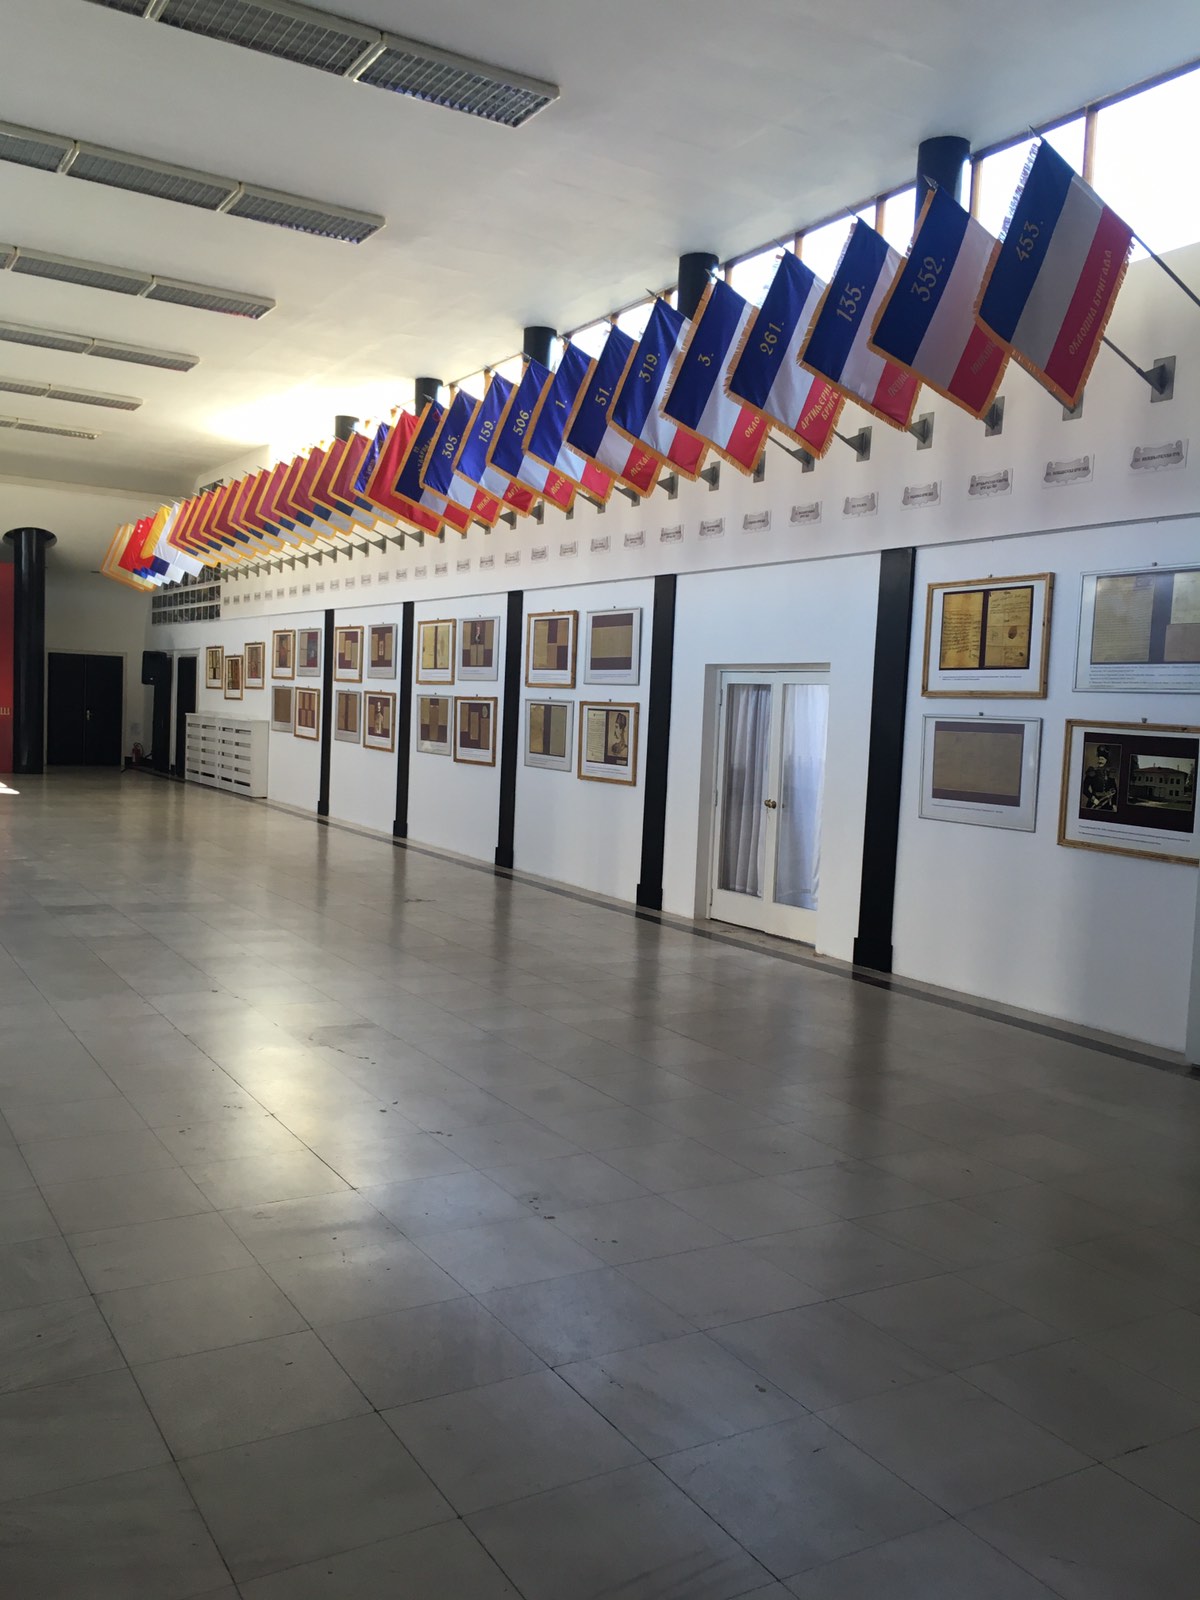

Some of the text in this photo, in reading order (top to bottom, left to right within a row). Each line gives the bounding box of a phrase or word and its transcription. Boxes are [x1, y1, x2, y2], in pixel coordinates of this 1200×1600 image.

[1016, 220, 1044, 261] 453.
[911, 256, 946, 302] 352.
[836, 283, 866, 322] 135.
[760, 321, 784, 356] 261.
[639, 352, 661, 383] 319.
[698, 352, 714, 367] 3.
[555, 400, 568, 409] 1.
[595, 387, 612, 406] 51.
[478, 420, 496, 443] 159.
[513, 409, 532, 436] 506.
[442, 434, 460, 459] 305.
